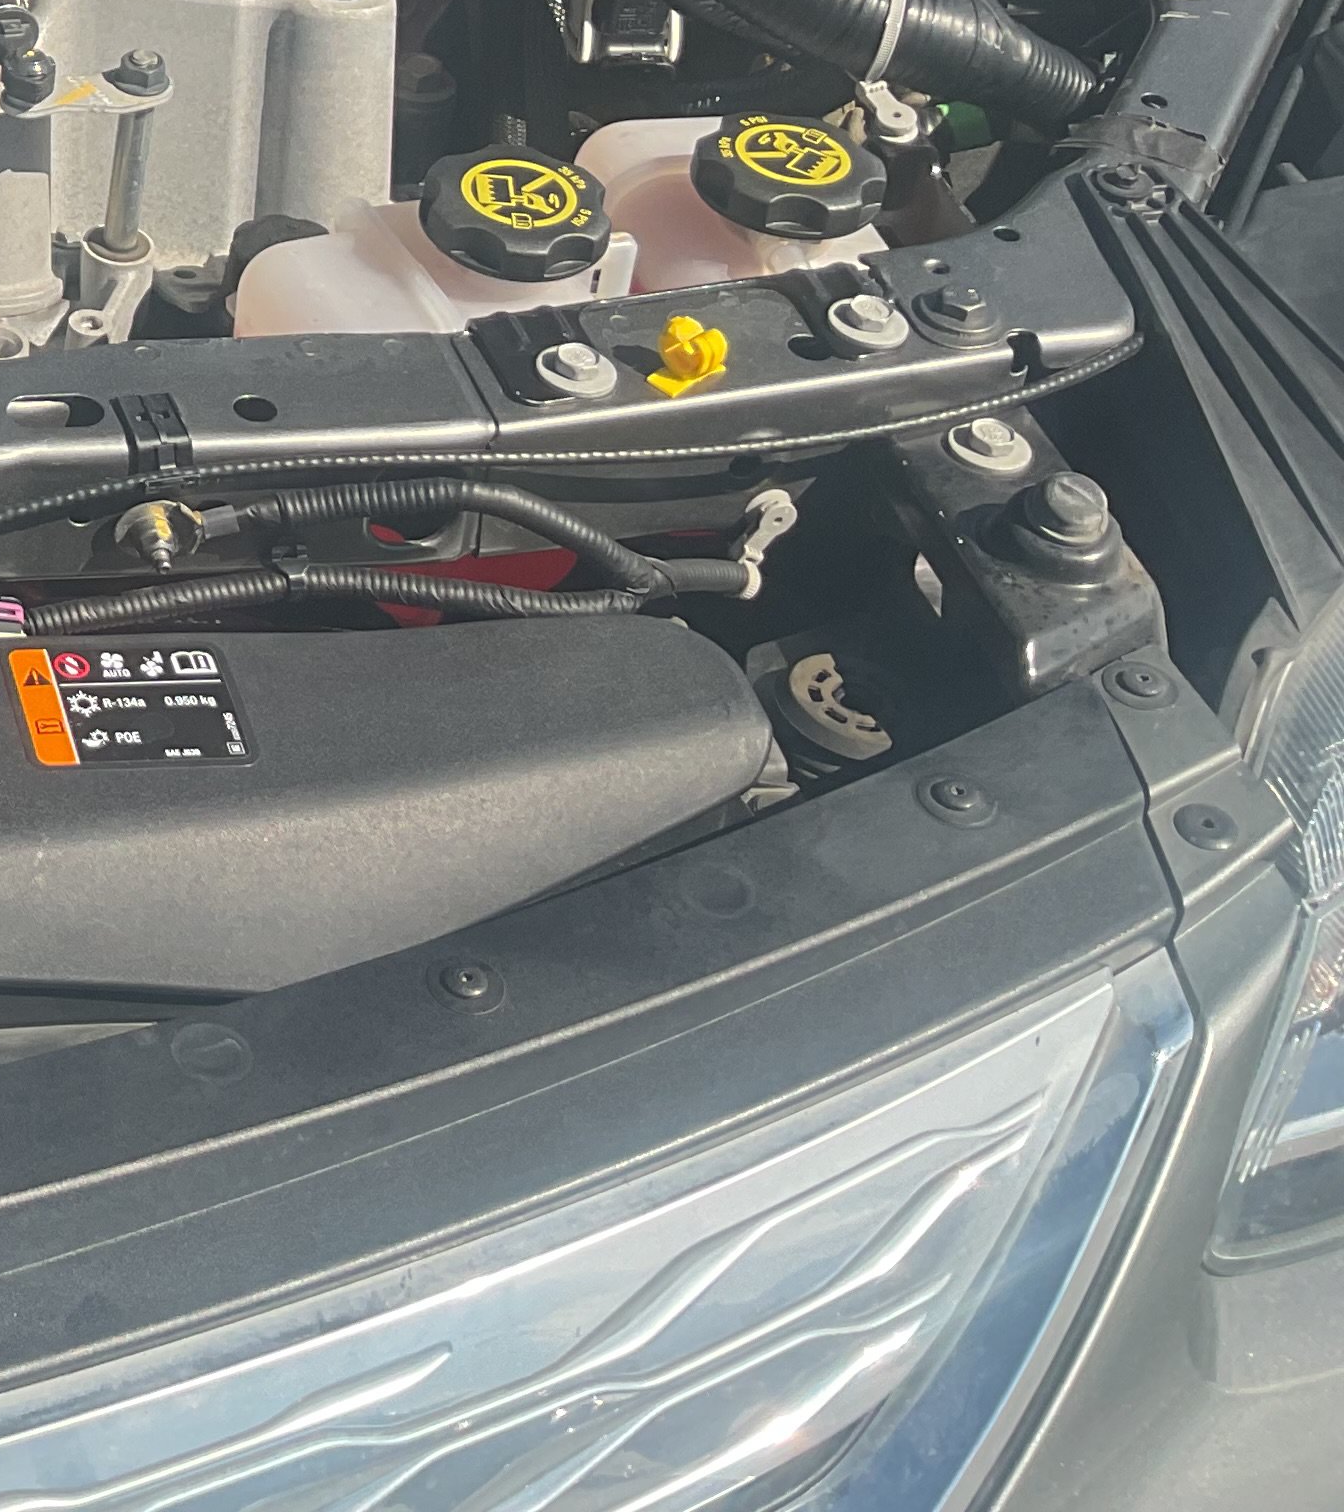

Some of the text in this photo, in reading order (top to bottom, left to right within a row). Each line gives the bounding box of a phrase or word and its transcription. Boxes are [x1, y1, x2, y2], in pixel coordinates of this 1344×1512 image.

[747, 115, 768, 125] PSI
[570, 213, 589, 227] PSI
[102, 668, 131, 678] AUTO
[102, 696, 146, 708] R-134a
[199, 695, 217, 707] kg
[115, 731, 142, 744] POE
